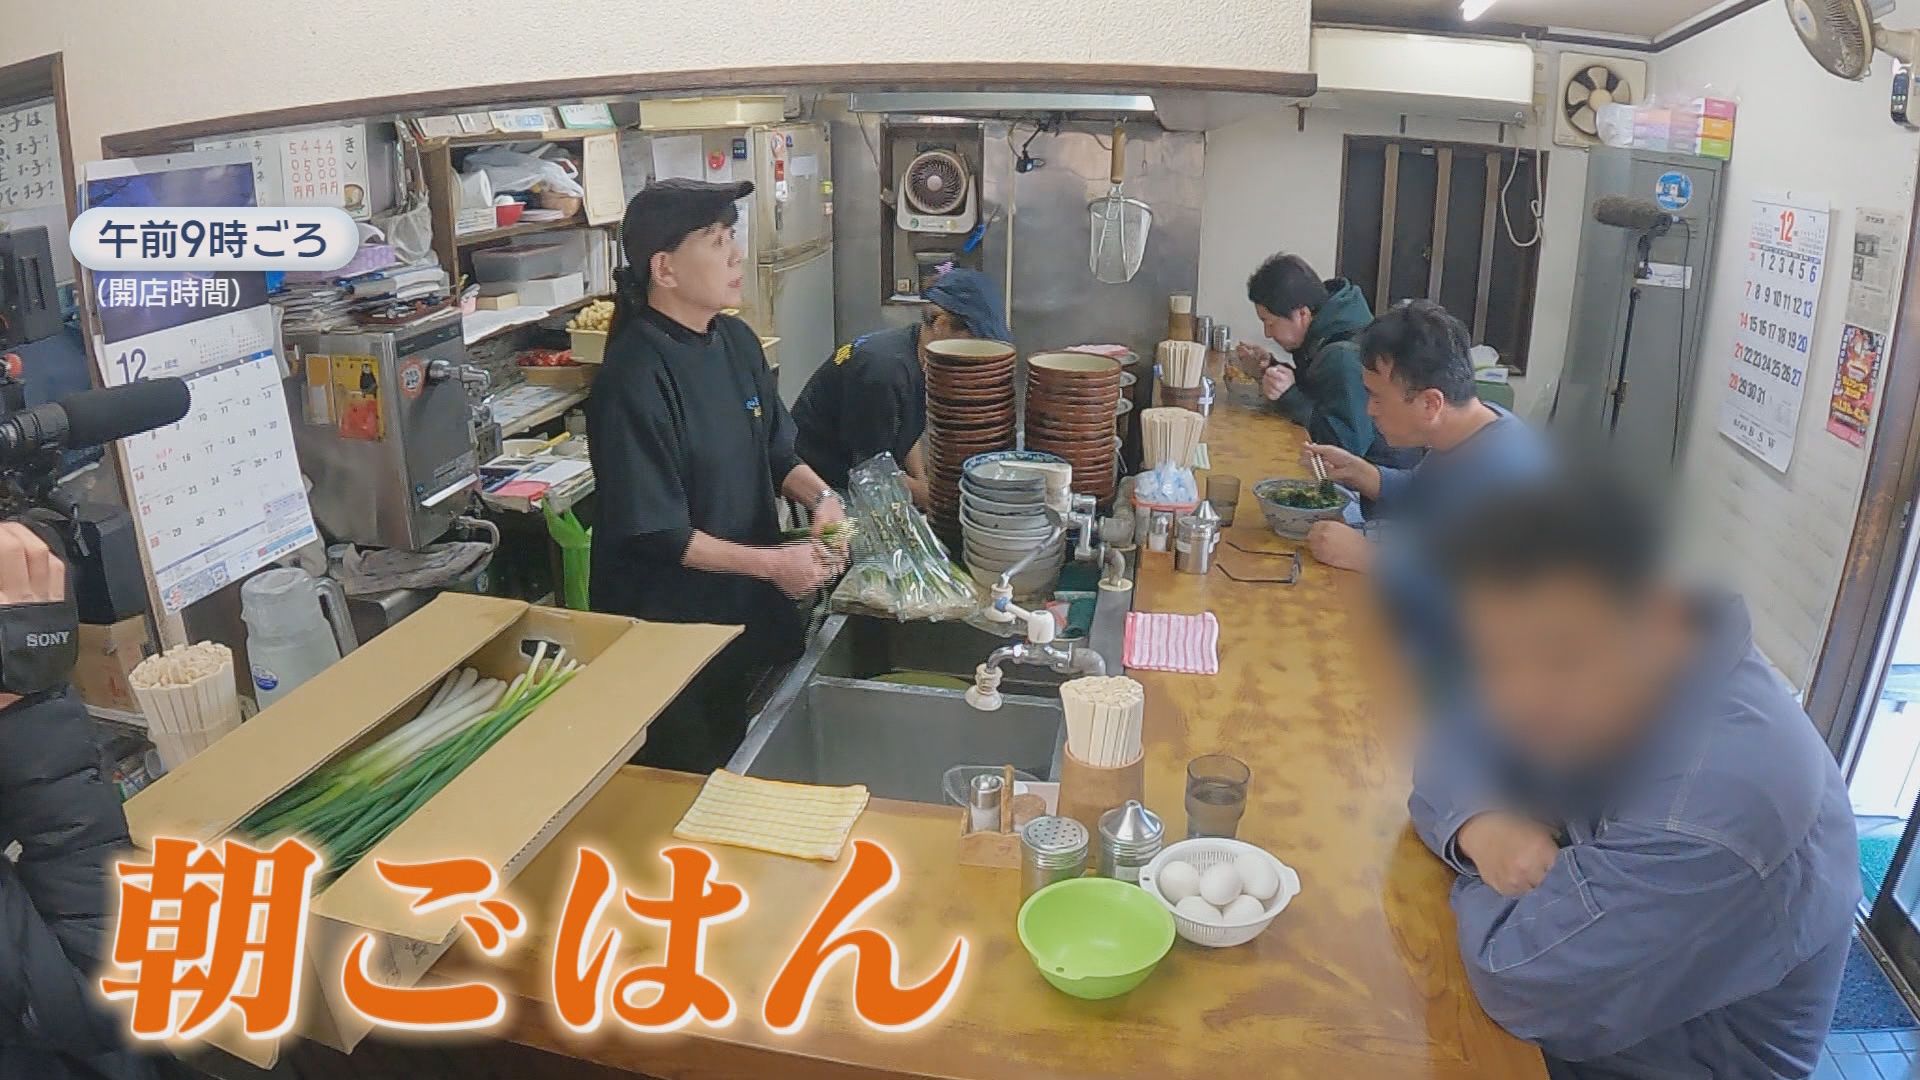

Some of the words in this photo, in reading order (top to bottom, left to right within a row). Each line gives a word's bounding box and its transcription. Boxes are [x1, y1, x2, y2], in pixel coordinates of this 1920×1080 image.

[1780, 211, 1795, 243] 12
[1760, 253, 1765, 268] 1
[1768, 255, 1776, 271] 2
[1778, 257, 1785, 274] 3
[1788, 260, 1794, 277] 4
[1798, 262, 1805, 280] 5
[1809, 265, 1817, 283] 6
[1745, 281, 1752, 297] 7
[1755, 284, 1761, 300] 8
[1764, 287, 1771, 303] 9
[1773, 290, 1782, 307] 10
[1783, 293, 1791, 311] 11
[1793, 297, 1802, 315] 12
[1803, 300, 1813, 319] 13
[1740, 312, 1748, 329] 14
[1749, 316, 1758, 333] 15
[1758, 320, 1767, 337] 16
[1768, 323, 1777, 340] 17
[1777, 327, 1787, 345] 18
[1788, 331, 1797, 349] 19
[1796, 334, 1808, 353] 20
[116, 348, 149, 385] 12
[1734, 343, 1744, 359] 21
[1743, 346, 1753, 364] 22
[1753, 350, 1762, 368] 23
[1761, 353, 1771, 372] 24
[1771, 358, 1781, 378] 25
[1781, 362, 1792, 382] 26
[1791, 367, 1802, 388] 27
[1738, 377, 1747, 395] 29
[1747, 382, 1756, 400] 30
[1757, 386, 1766, 405] 31
[26, 631, 70, 647] SONY
